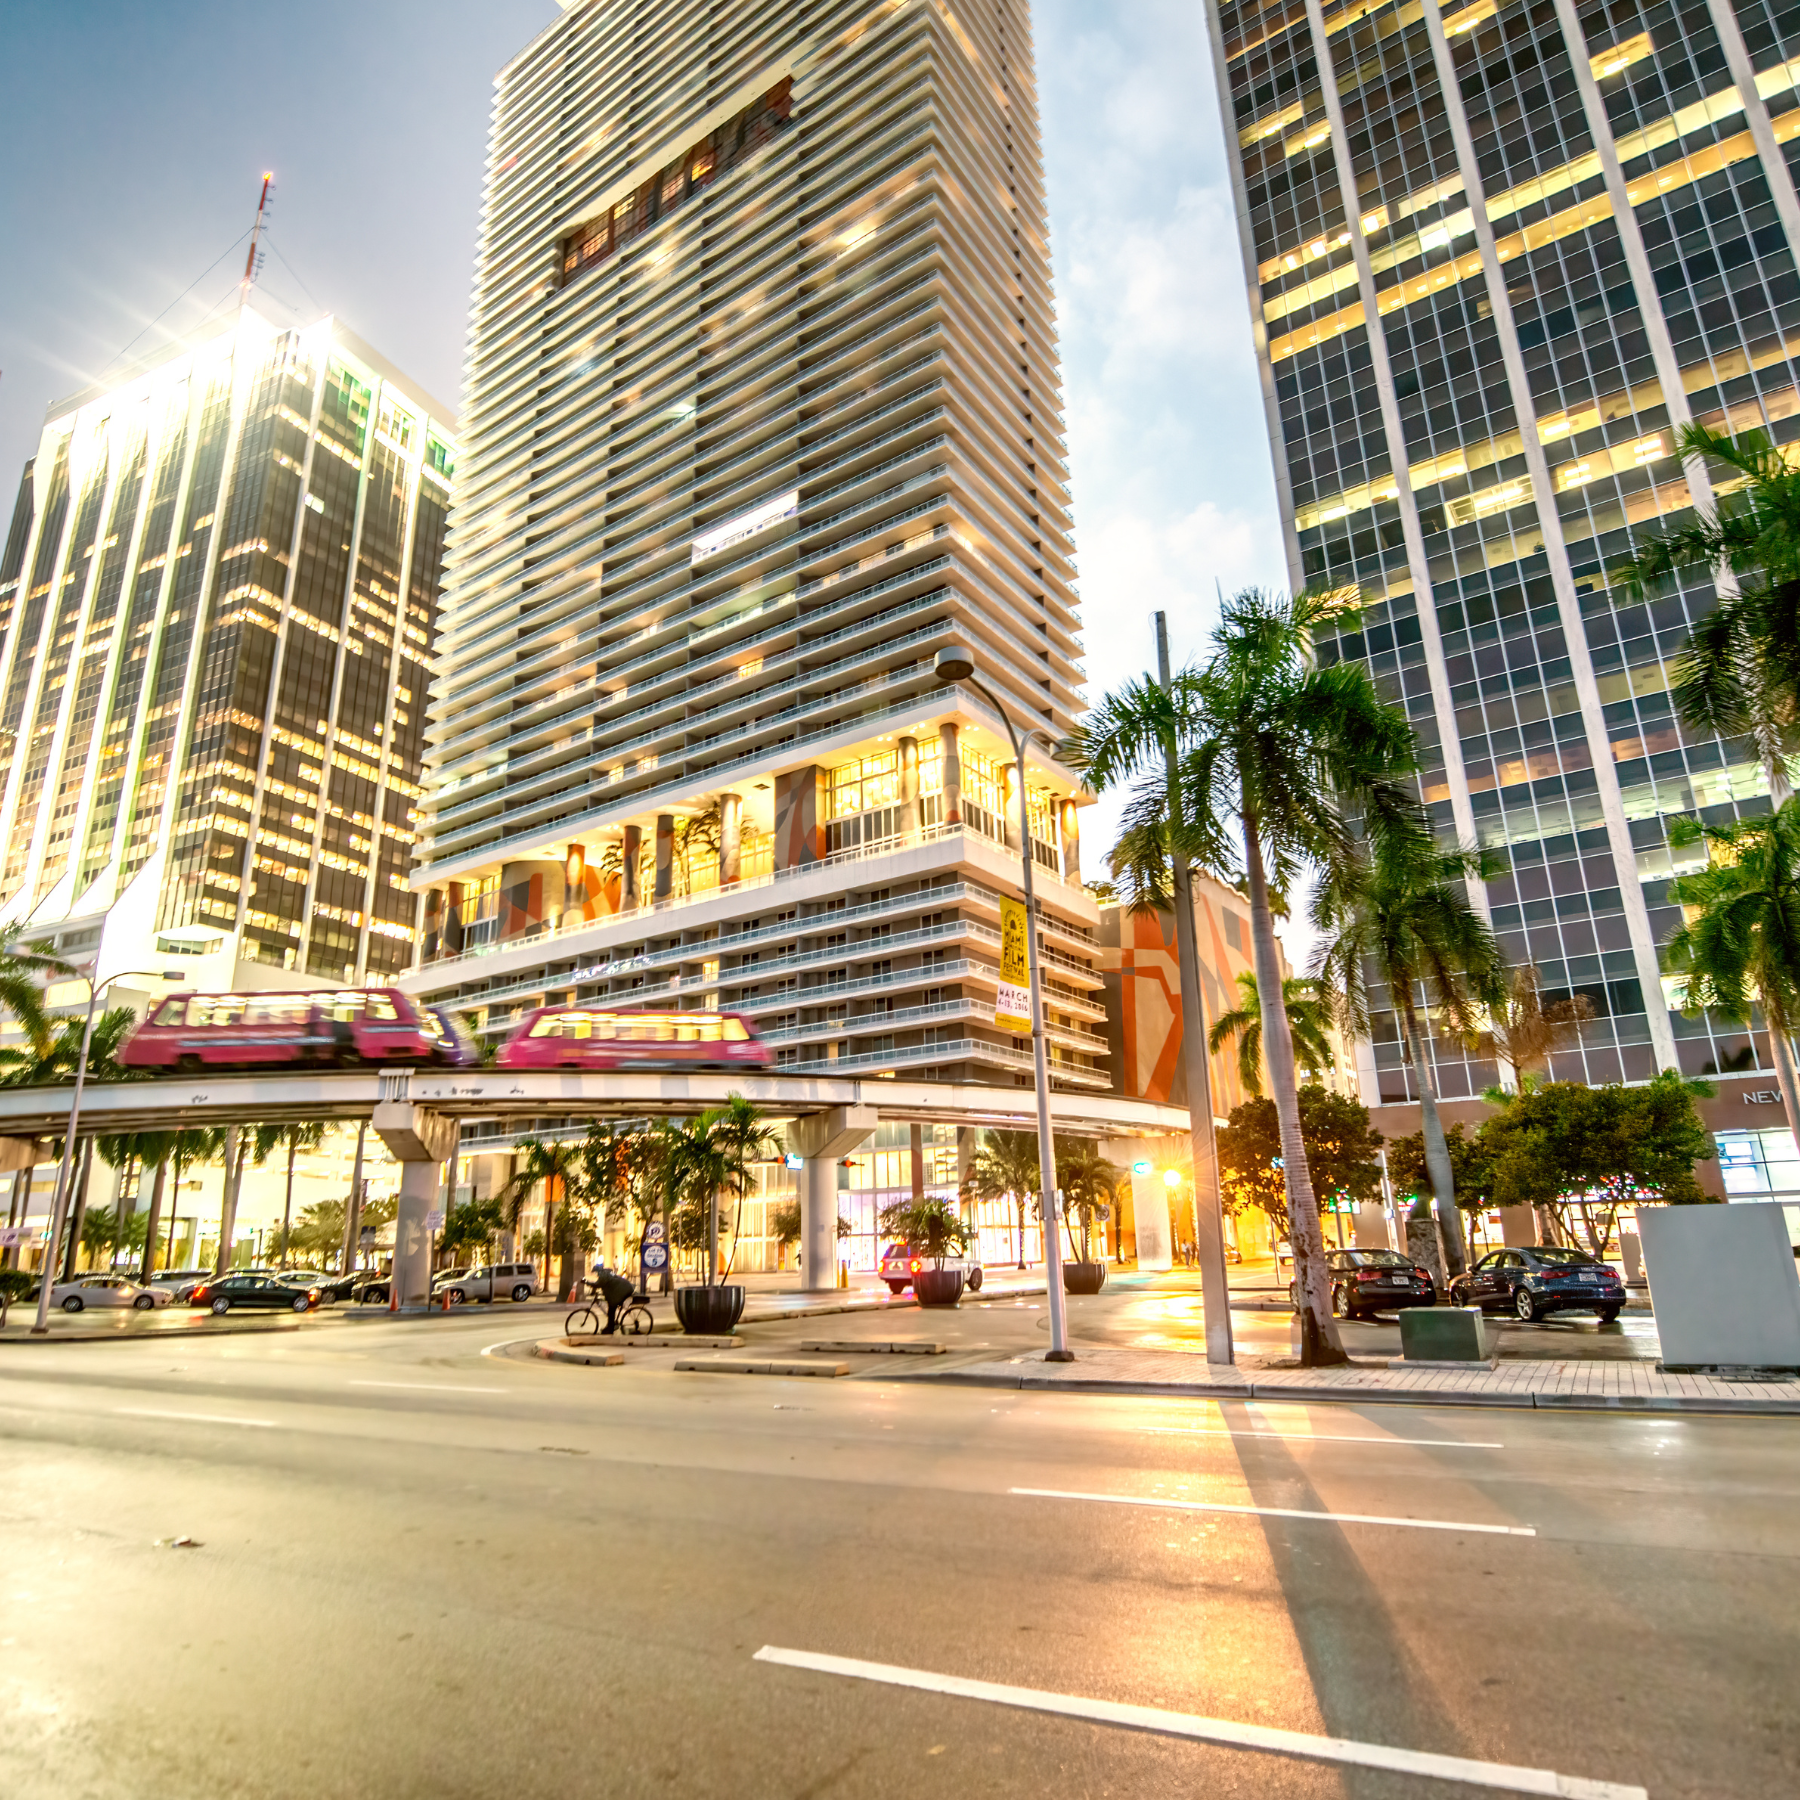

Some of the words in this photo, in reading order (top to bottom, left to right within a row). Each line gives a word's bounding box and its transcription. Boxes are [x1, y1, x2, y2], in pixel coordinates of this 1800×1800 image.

[1004, 930, 1024, 947] MIAMI
[1003, 947, 1024, 967] FILM
[999, 987, 1028, 1003] MARCH
